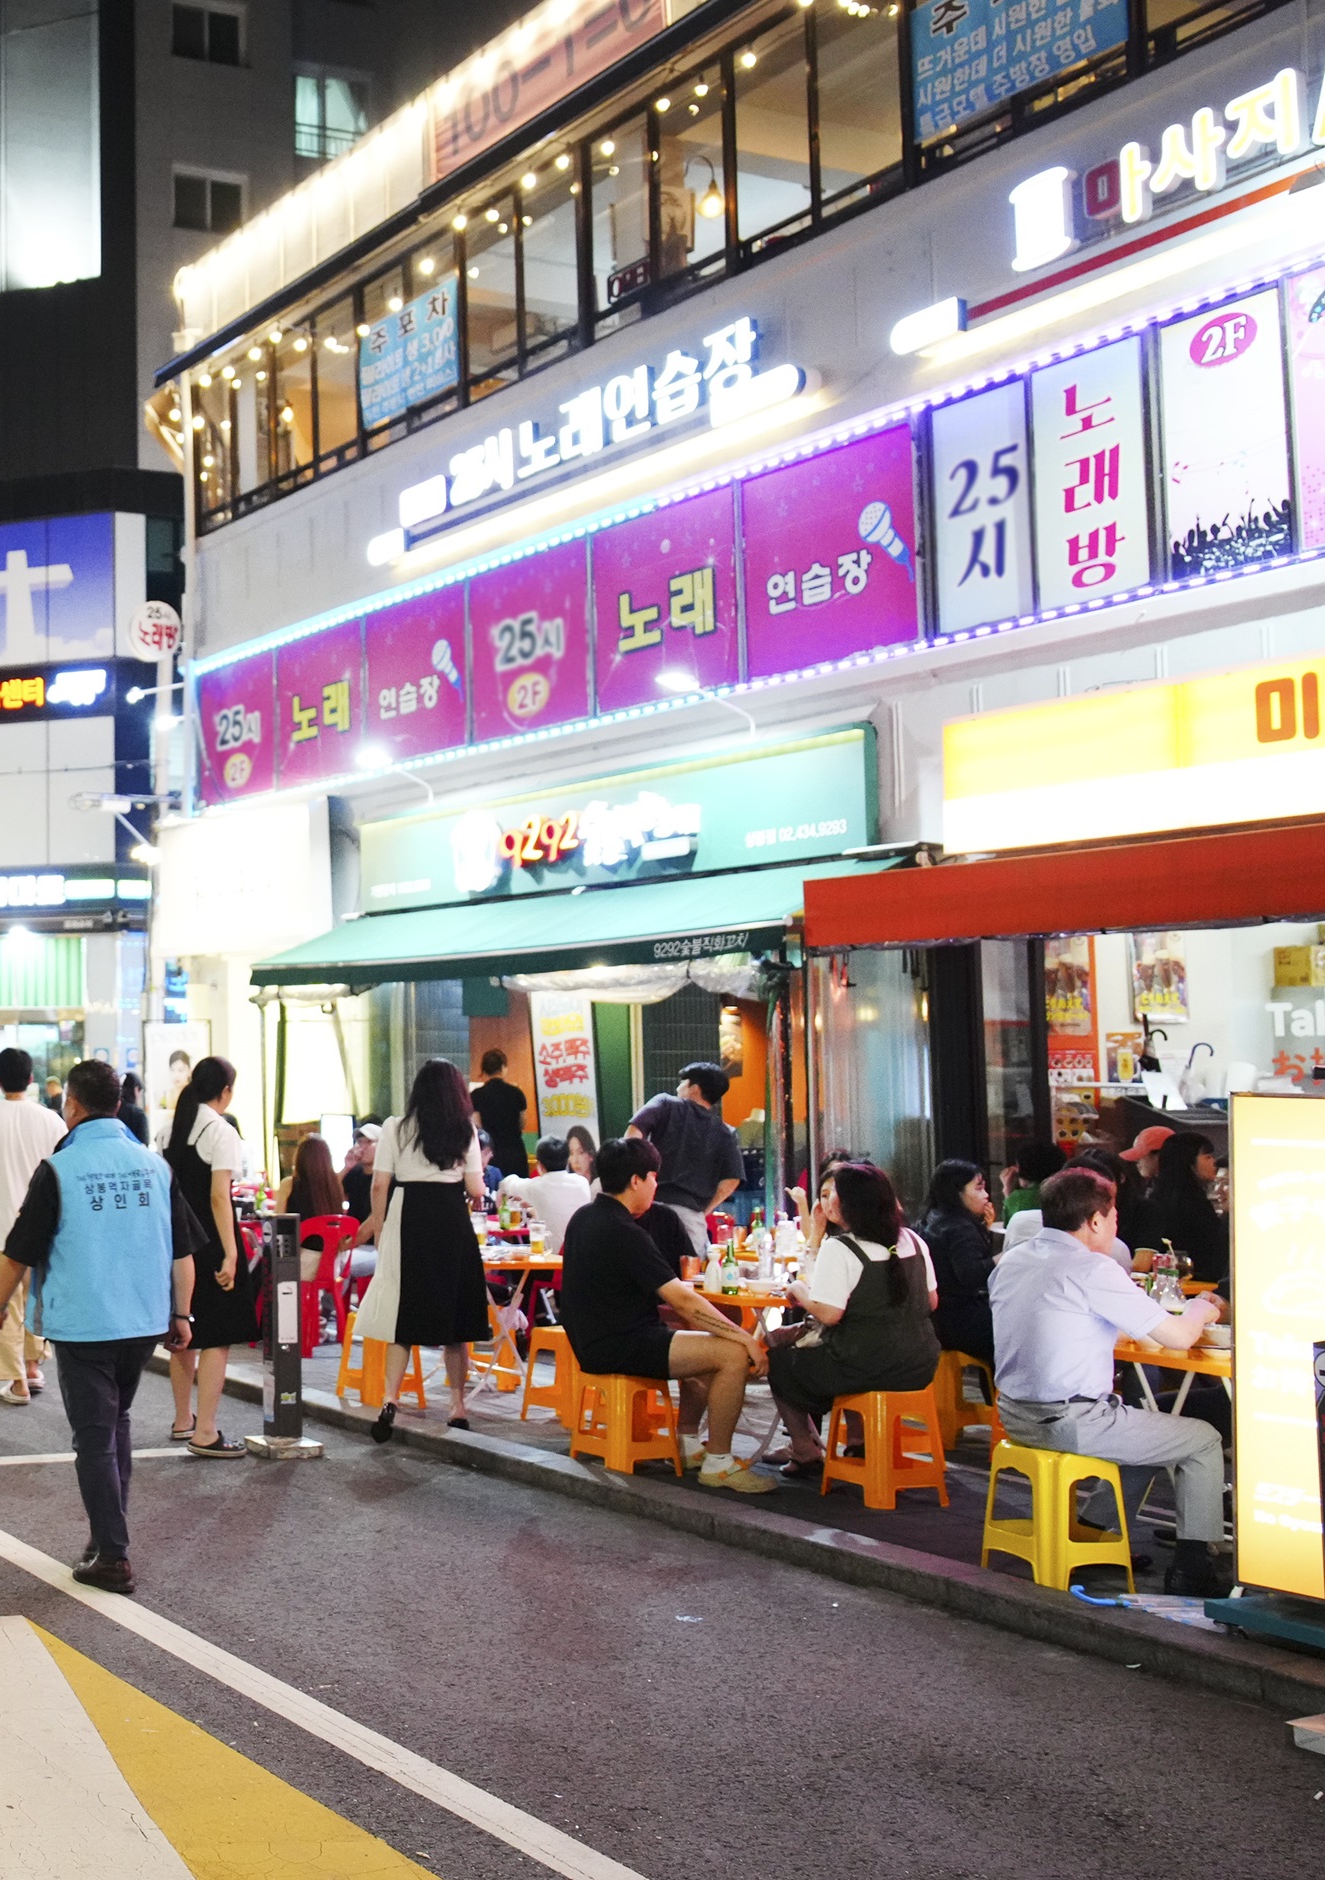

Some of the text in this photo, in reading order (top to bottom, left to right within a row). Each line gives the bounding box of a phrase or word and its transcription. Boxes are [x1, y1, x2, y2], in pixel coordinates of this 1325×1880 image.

[1052, 24, 1097, 64] 영입
[1085, 68, 1301, 224] 마사지
[1201, 314, 1247, 366] 2F
[517, 316, 757, 479] 노래연습장
[1060, 383, 1125, 588] 노래방
[766, 548, 873, 616] 연습장
[138, 620, 179, 651] 노래방
[617, 566, 717, 654] 노래
[498, 613, 564, 670] 25시
[291, 680, 351, 744] 노래
[378, 674, 440, 720] 연습장
[516, 680, 542, 711] 2F
[217, 706, 260, 748] 25시
[229, 760, 247, 783] 2F
[89, 1191, 150, 1212] 상인회
